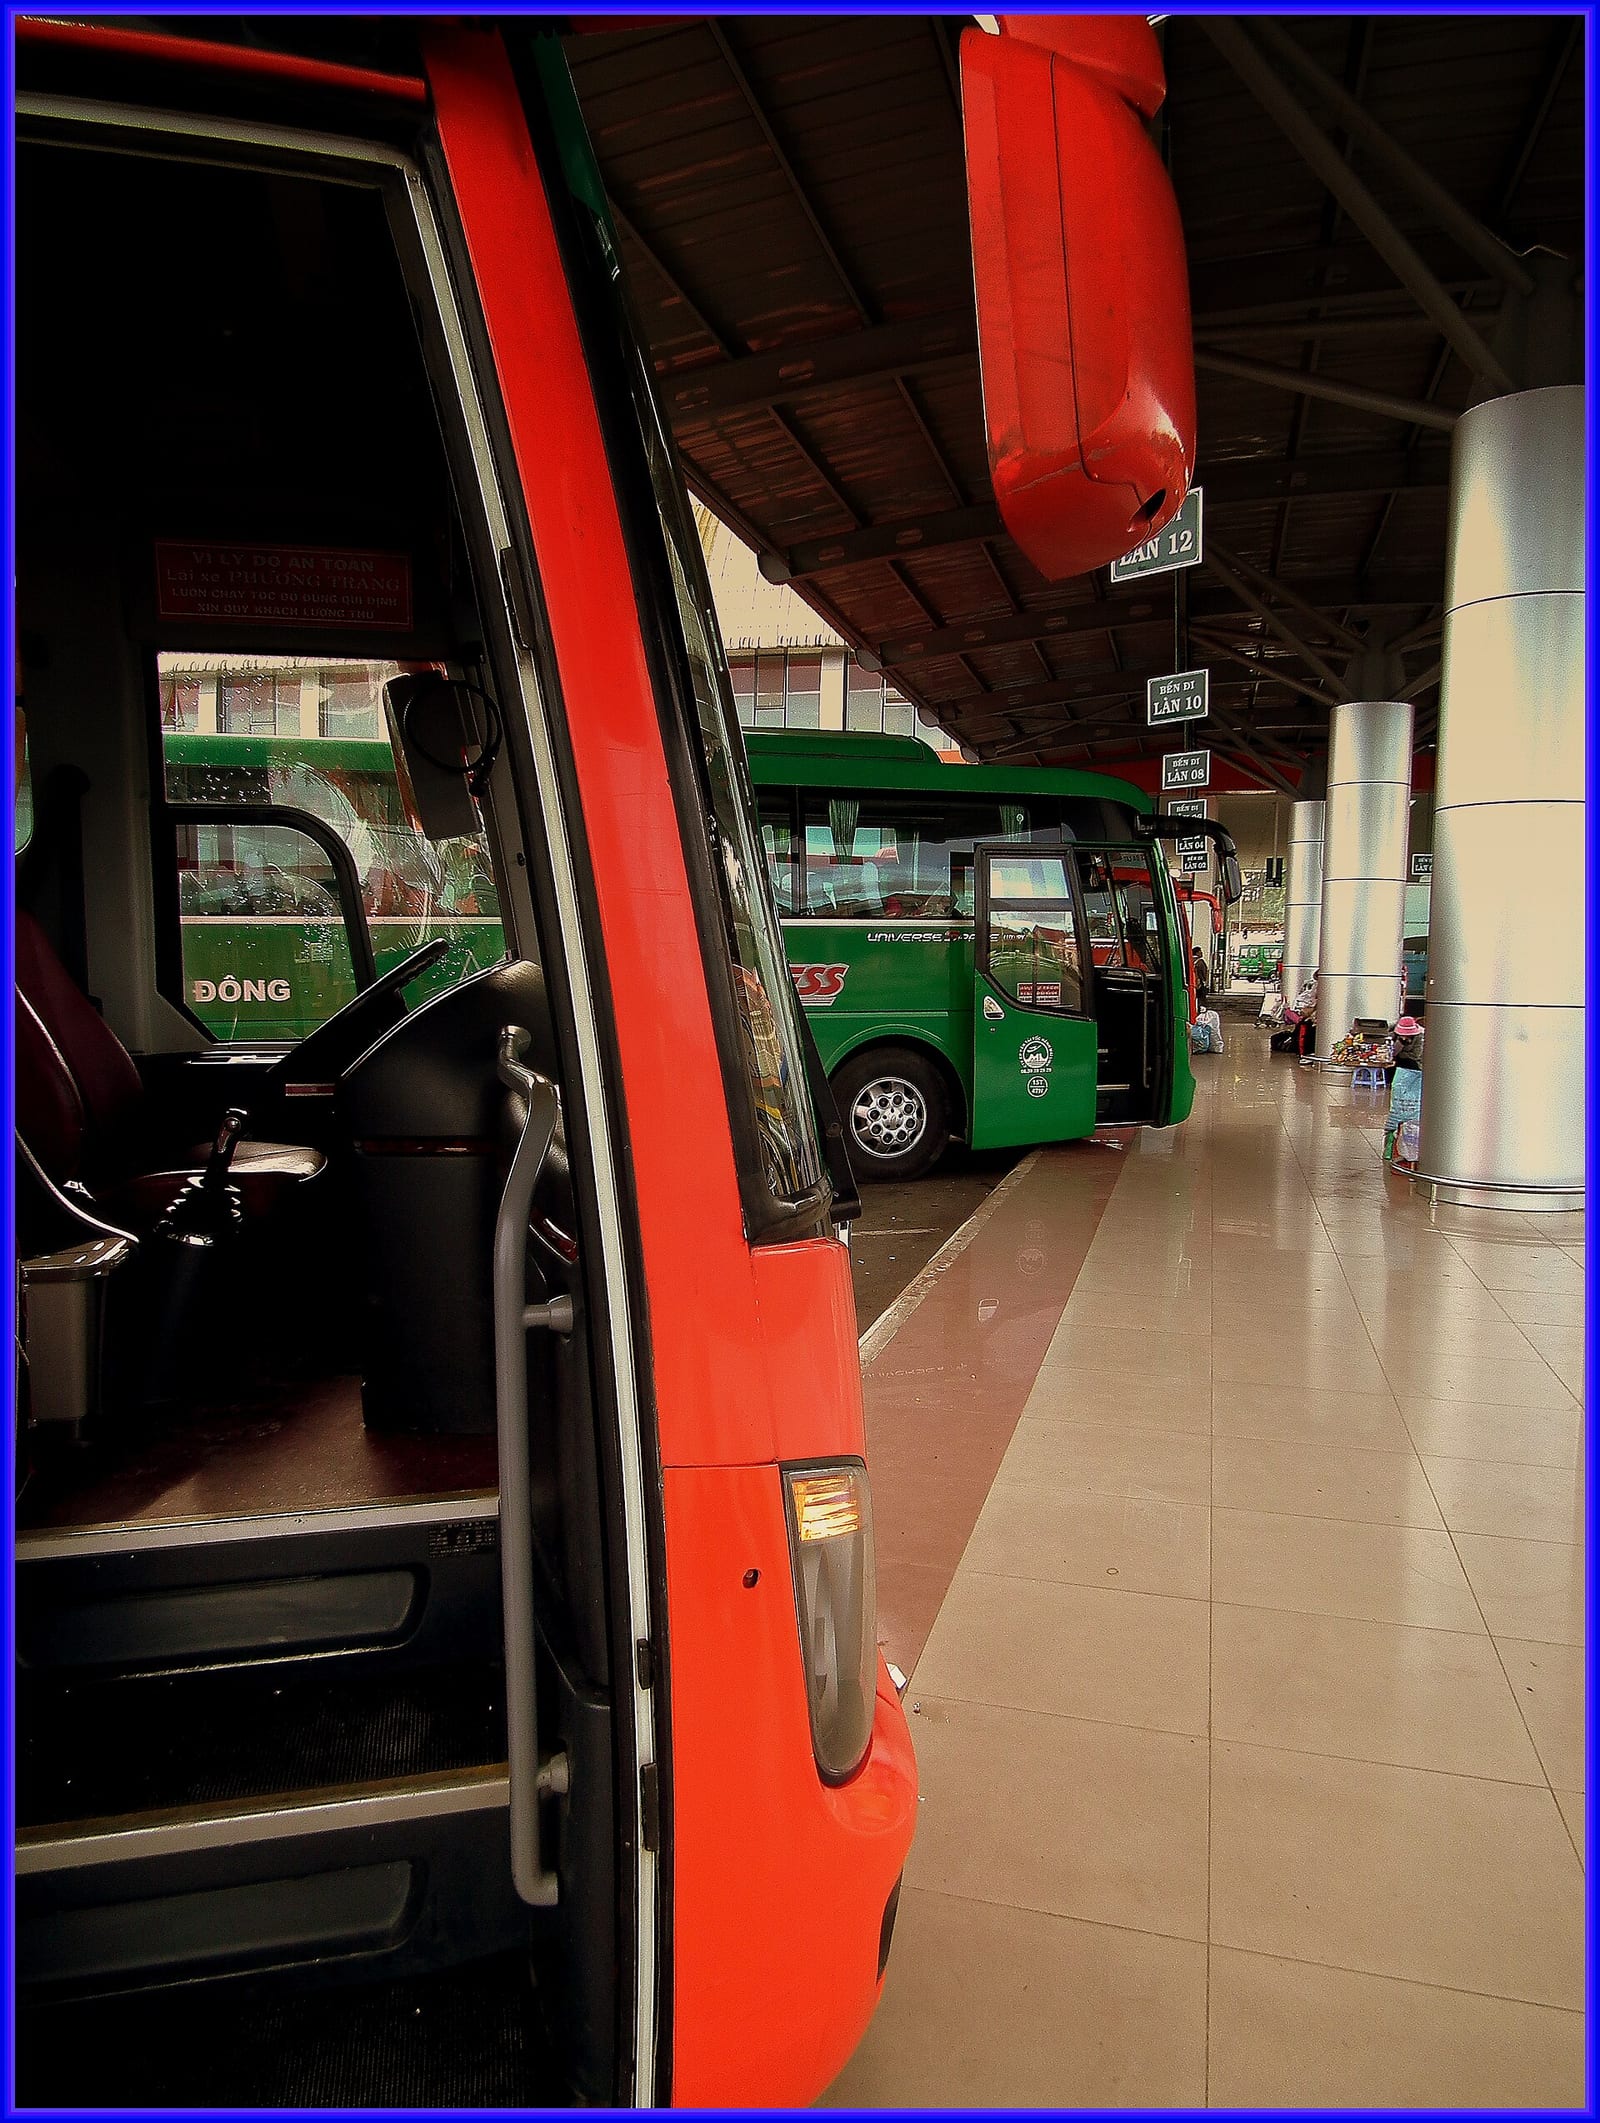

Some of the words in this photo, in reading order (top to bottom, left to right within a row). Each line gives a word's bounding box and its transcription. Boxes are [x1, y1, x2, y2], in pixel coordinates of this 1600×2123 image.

[1168, 529, 1193, 555] 12
[327, 575, 400, 591] TRANG
[1183, 679, 1196, 691] ĐI
[1185, 695, 1202, 711] 10
[1190, 768, 1205, 781] 08
[866, 931, 943, 943] UNIVERSE
[192, 974, 291, 1003] ĐÔNG
